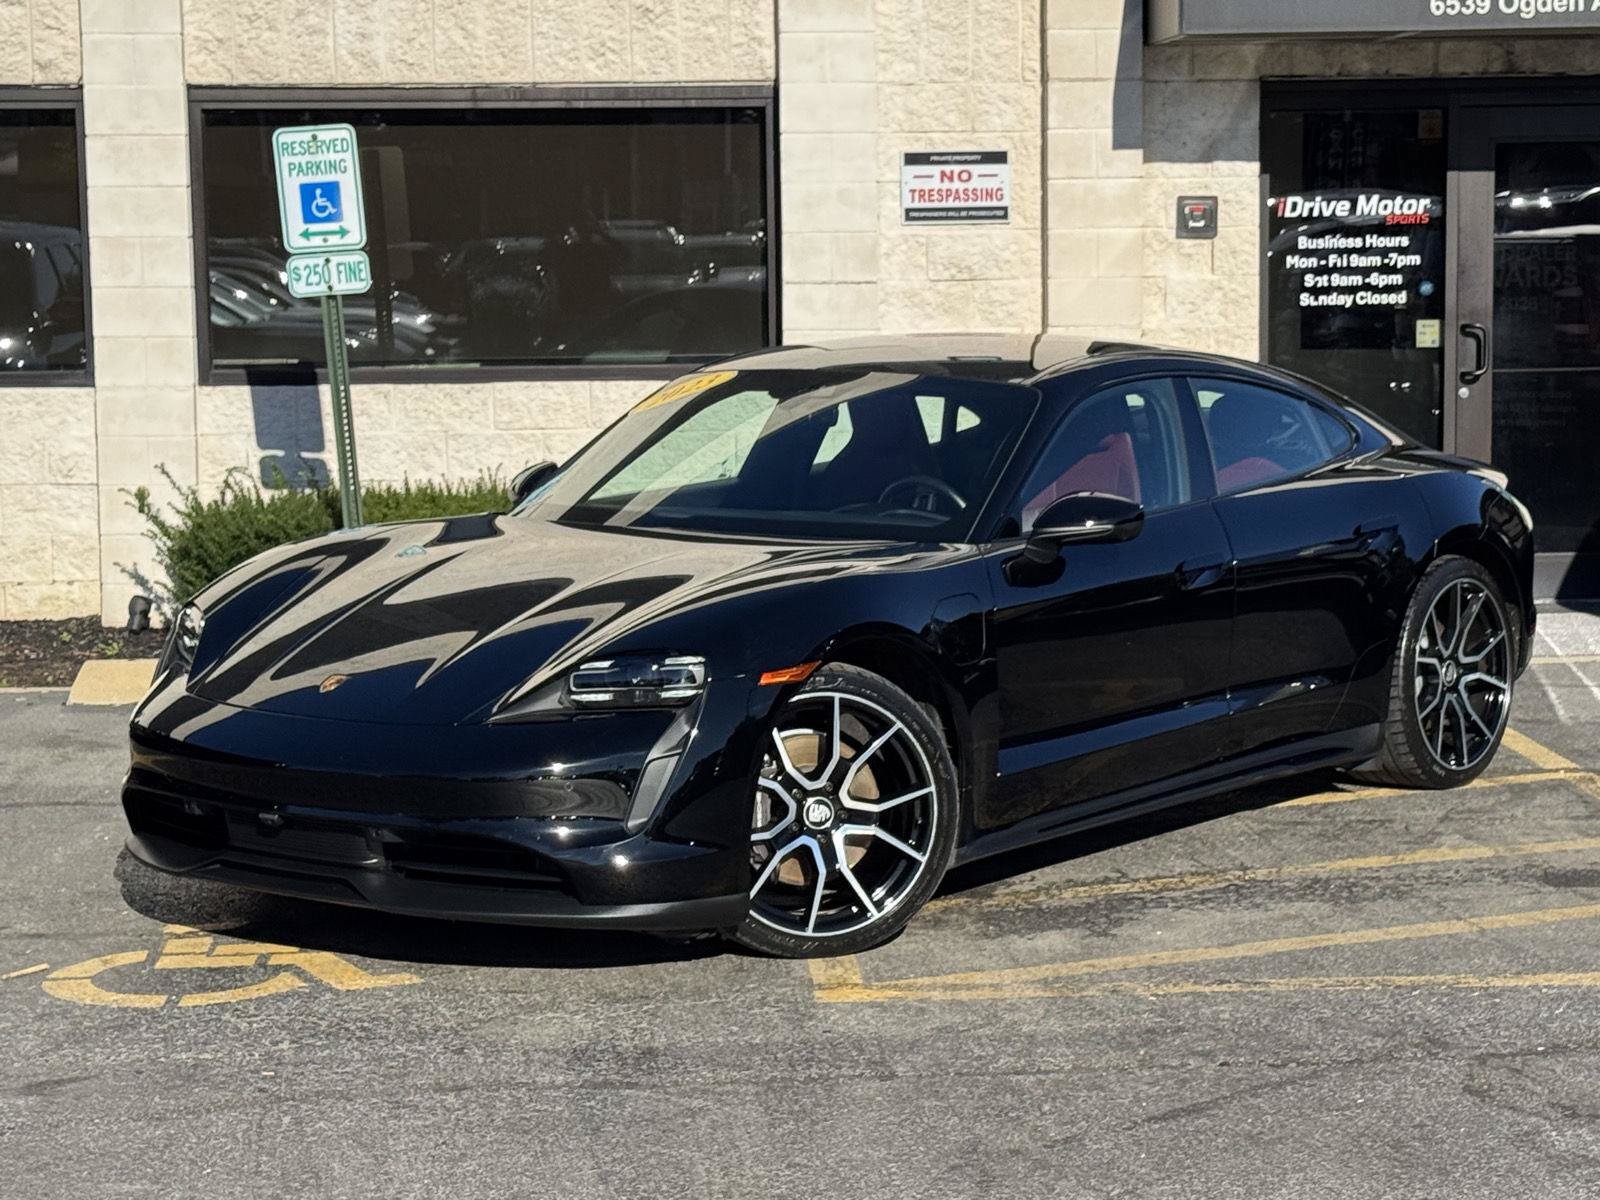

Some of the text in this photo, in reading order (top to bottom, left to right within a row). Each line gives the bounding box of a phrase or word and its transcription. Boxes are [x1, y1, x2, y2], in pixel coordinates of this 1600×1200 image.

[1429, 0, 1491, 16] 6539
[1498, 0, 1585, 19] Ogden
[280, 137, 349, 157] RESERVED
[288, 158, 347, 177] PARKING
[940, 169, 972, 183] NO
[908, 187, 1004, 204] TRESPASSING
[1277, 194, 1431, 218] iDrive Motor
[1385, 214, 1430, 225] SPORTS
[1297, 233, 1409, 249] Business Hours
[1286, 254, 1318, 269] Mon
[1328, 254, 1348, 269] Fri
[1349, 253, 1382, 268] 9am
[292, 260, 366, 286] $250 FINE
[1303, 273, 1329, 288] Sat
[1330, 273, 1363, 287] 9am
[1299, 290, 1408, 308] Sunday Closed
